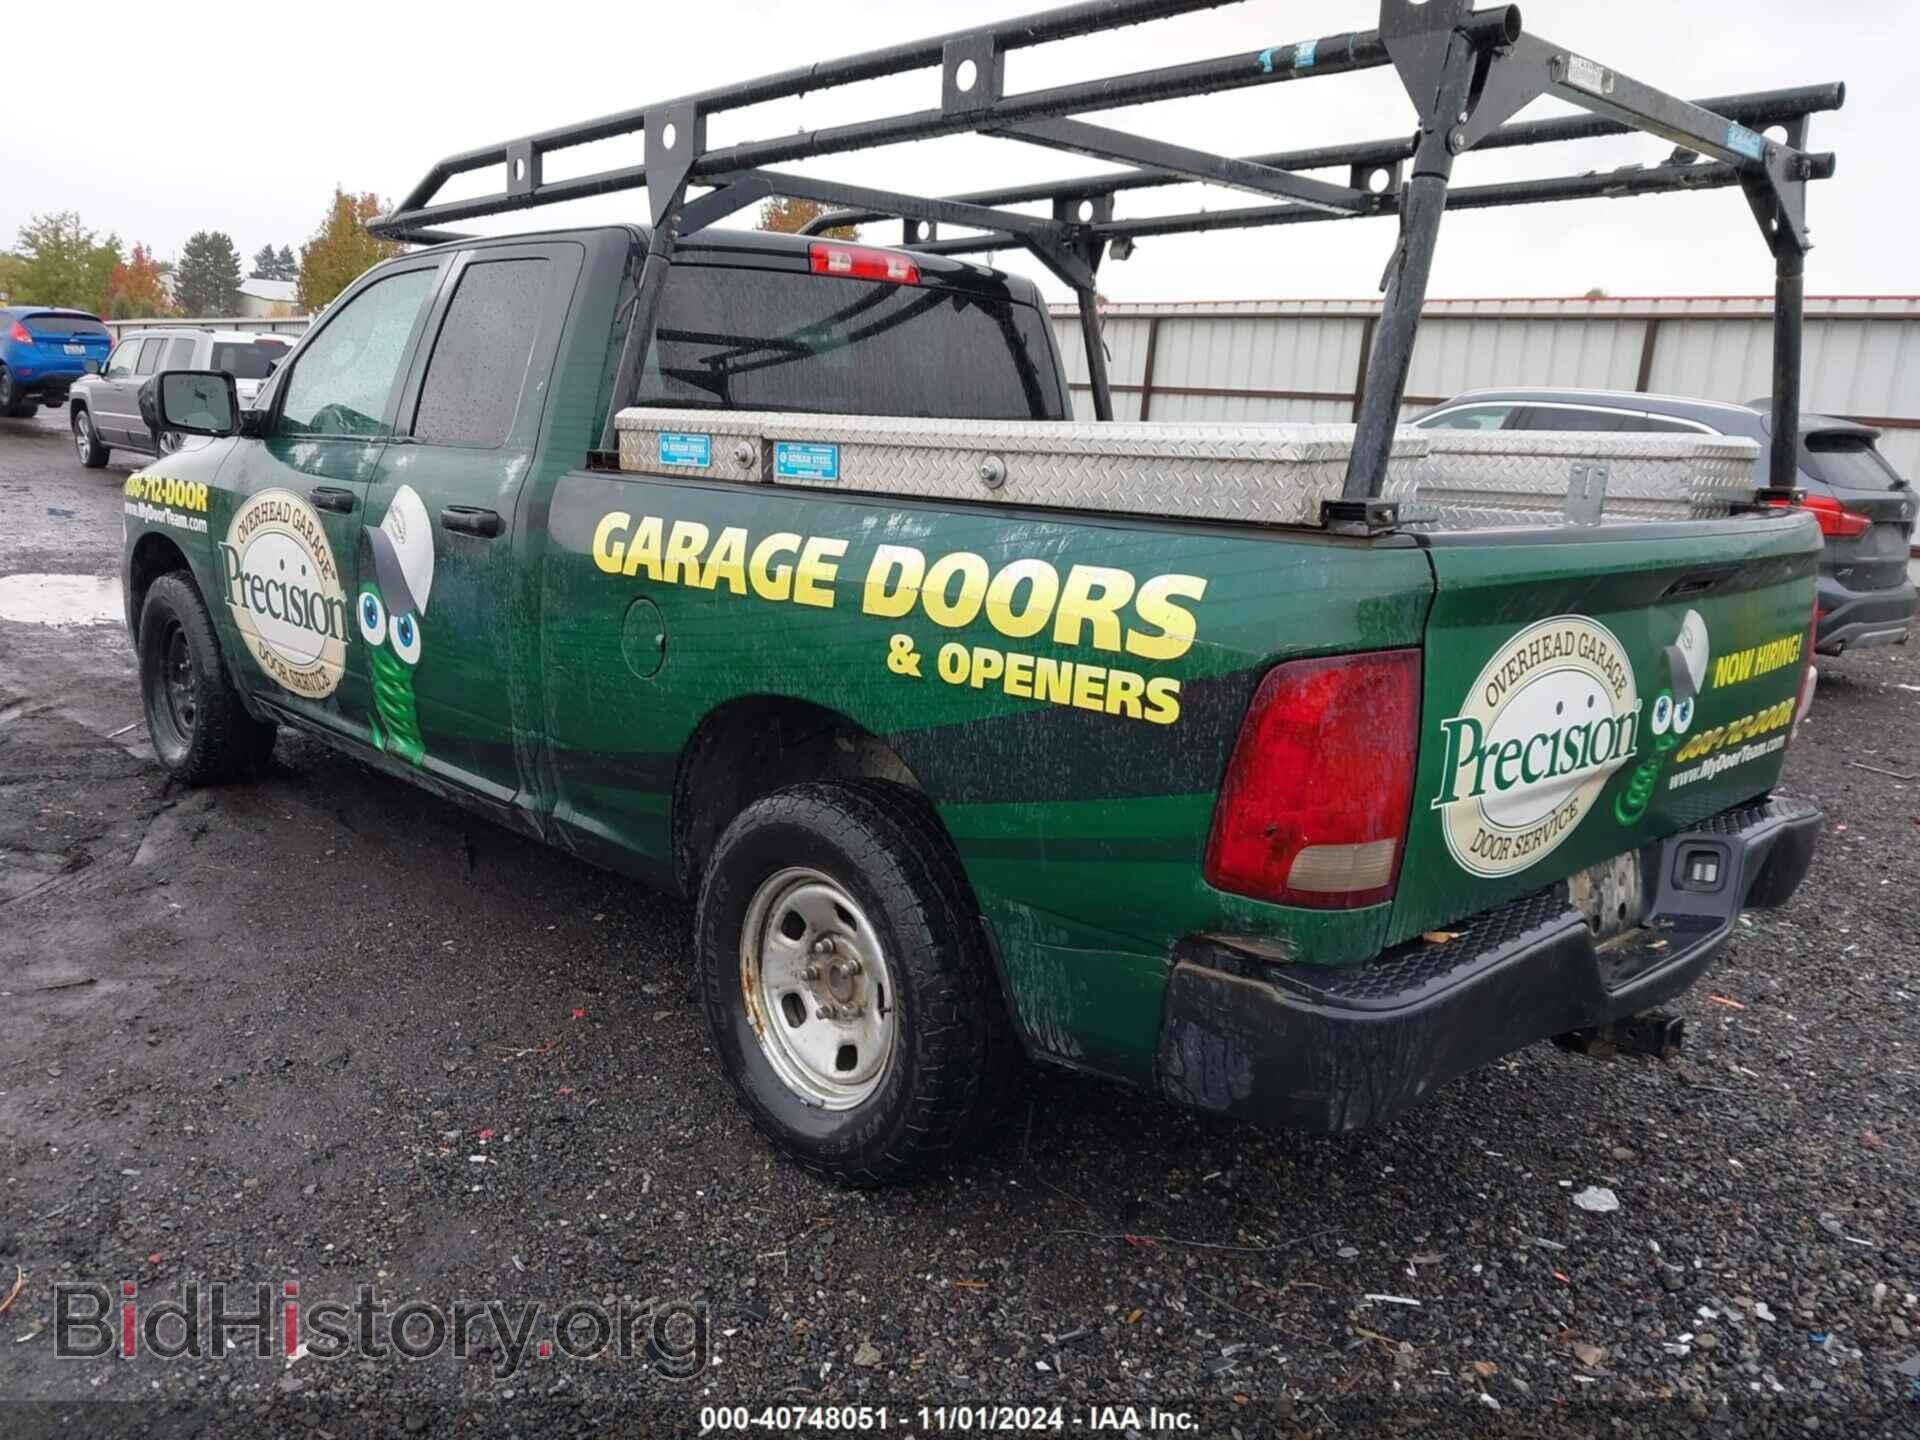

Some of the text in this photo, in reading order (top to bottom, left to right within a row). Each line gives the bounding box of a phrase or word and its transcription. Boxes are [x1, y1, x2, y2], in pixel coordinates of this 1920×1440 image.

[237, 501, 291, 545] OVERHEAD
[292, 507, 331, 580] GARAGE
[219, 541, 352, 645] Precision
[592, 511, 1208, 661] GARAGE DOORS
[257, 641, 331, 692] DOOR SERVICE
[887, 633, 1181, 725] & OPENERS
[1485, 631, 1628, 708] OVERHEAD GARAGE
[1712, 633, 1803, 689] NOW HIRING!
[1433, 708, 1641, 808] Precision
[1470, 797, 1580, 861] DOOR SERVICE
